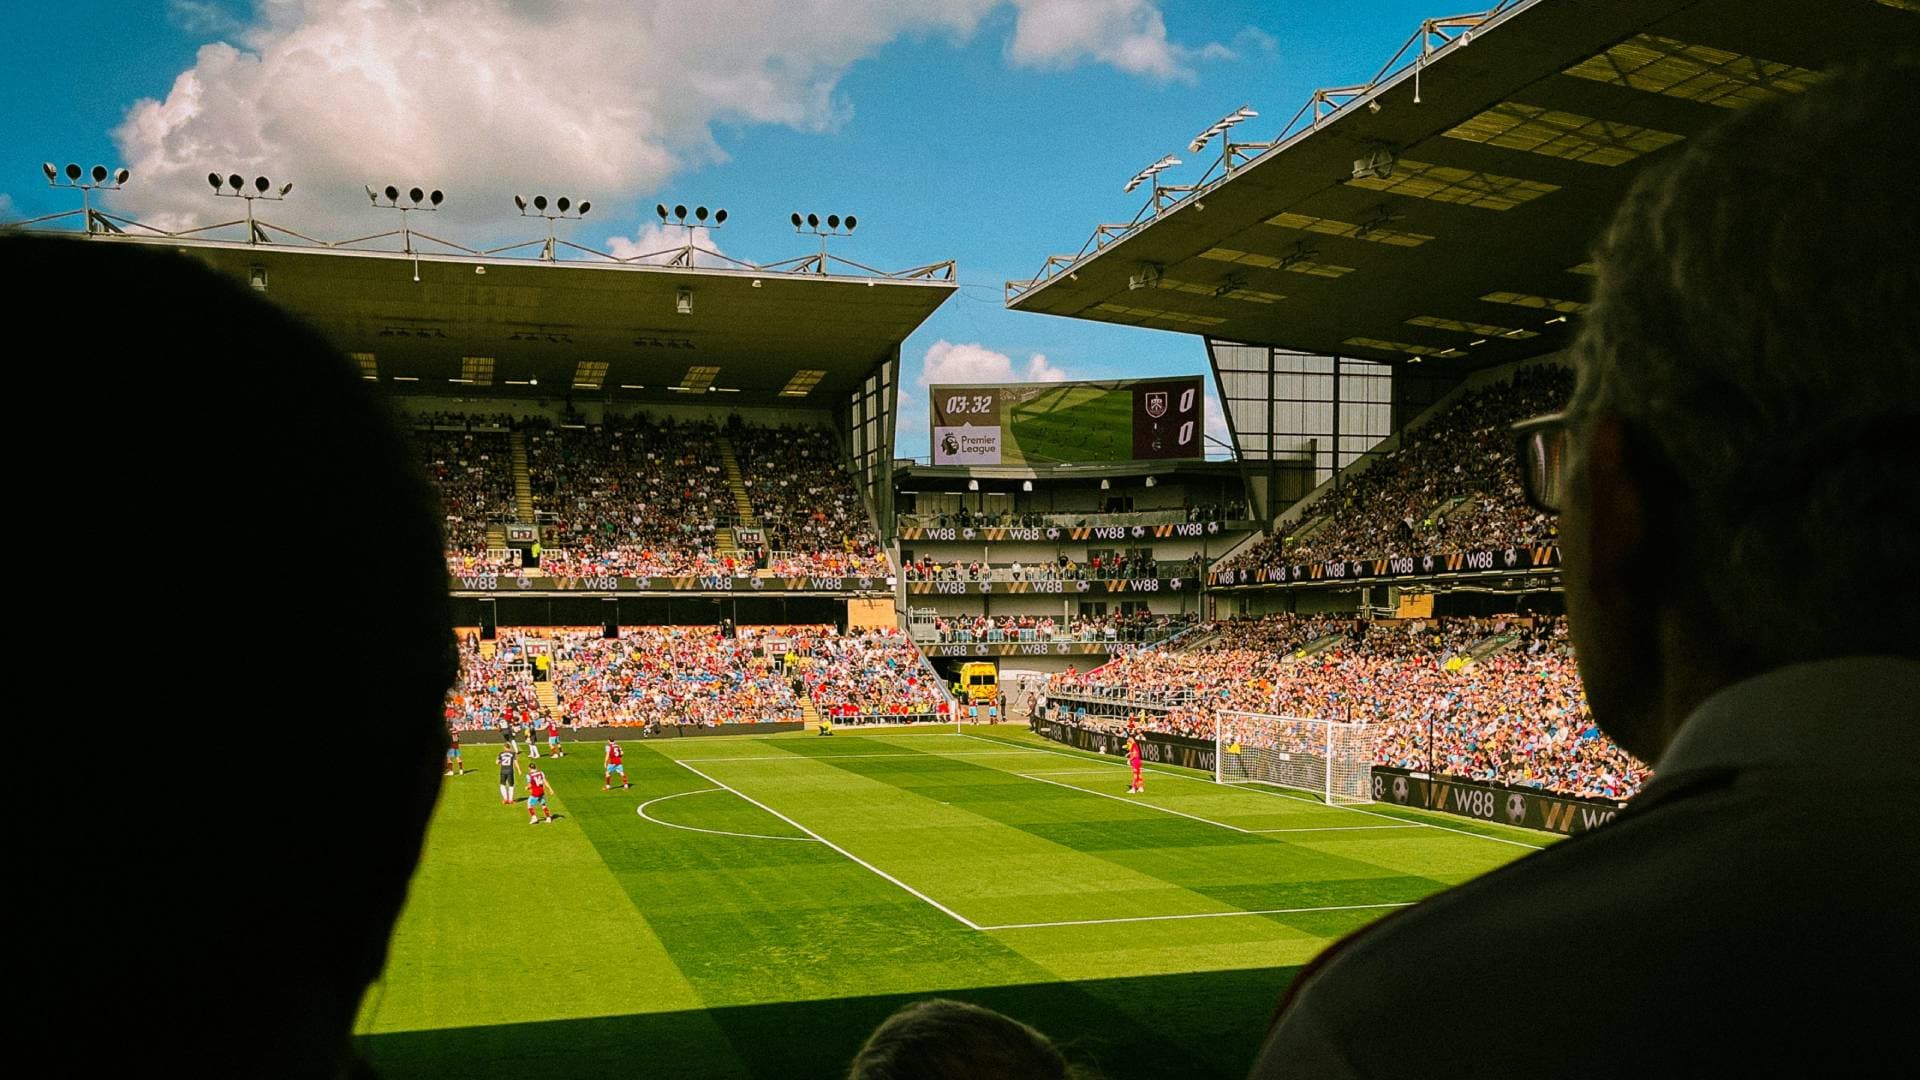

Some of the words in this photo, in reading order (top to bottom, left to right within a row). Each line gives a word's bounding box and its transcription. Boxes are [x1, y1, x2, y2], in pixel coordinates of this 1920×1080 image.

[946, 396, 992, 414] 03:32
[1180, 388, 1195, 413] 0
[961, 435, 996, 444] Premier
[1179, 421, 1194, 446] 0
[961, 445, 996, 455] League
[926, 528, 956, 540] W88
[1010, 528, 1039, 540] W88
[1094, 527, 1125, 539] W88
[1176, 523, 1203, 536] W88
[1219, 571, 1235, 585] W88
[1268, 566, 1286, 582] W88
[1325, 562, 1345, 578] W88
[1390, 557, 1414, 574] W88
[1466, 551, 1493, 569] W88
[461, 577, 498, 590] W88
[584, 577, 618, 590] W88
[700, 577, 733, 590] W88
[811, 577, 843, 590] W88
[936, 582, 966, 594] W88
[1032, 581, 1063, 593] W88
[1130, 579, 1159, 592] W88
[940, 645, 967, 656] W88
[1021, 643, 1048, 655] W88
[1141, 744, 1160, 762] W88
[1453, 788, 1495, 818] W88
